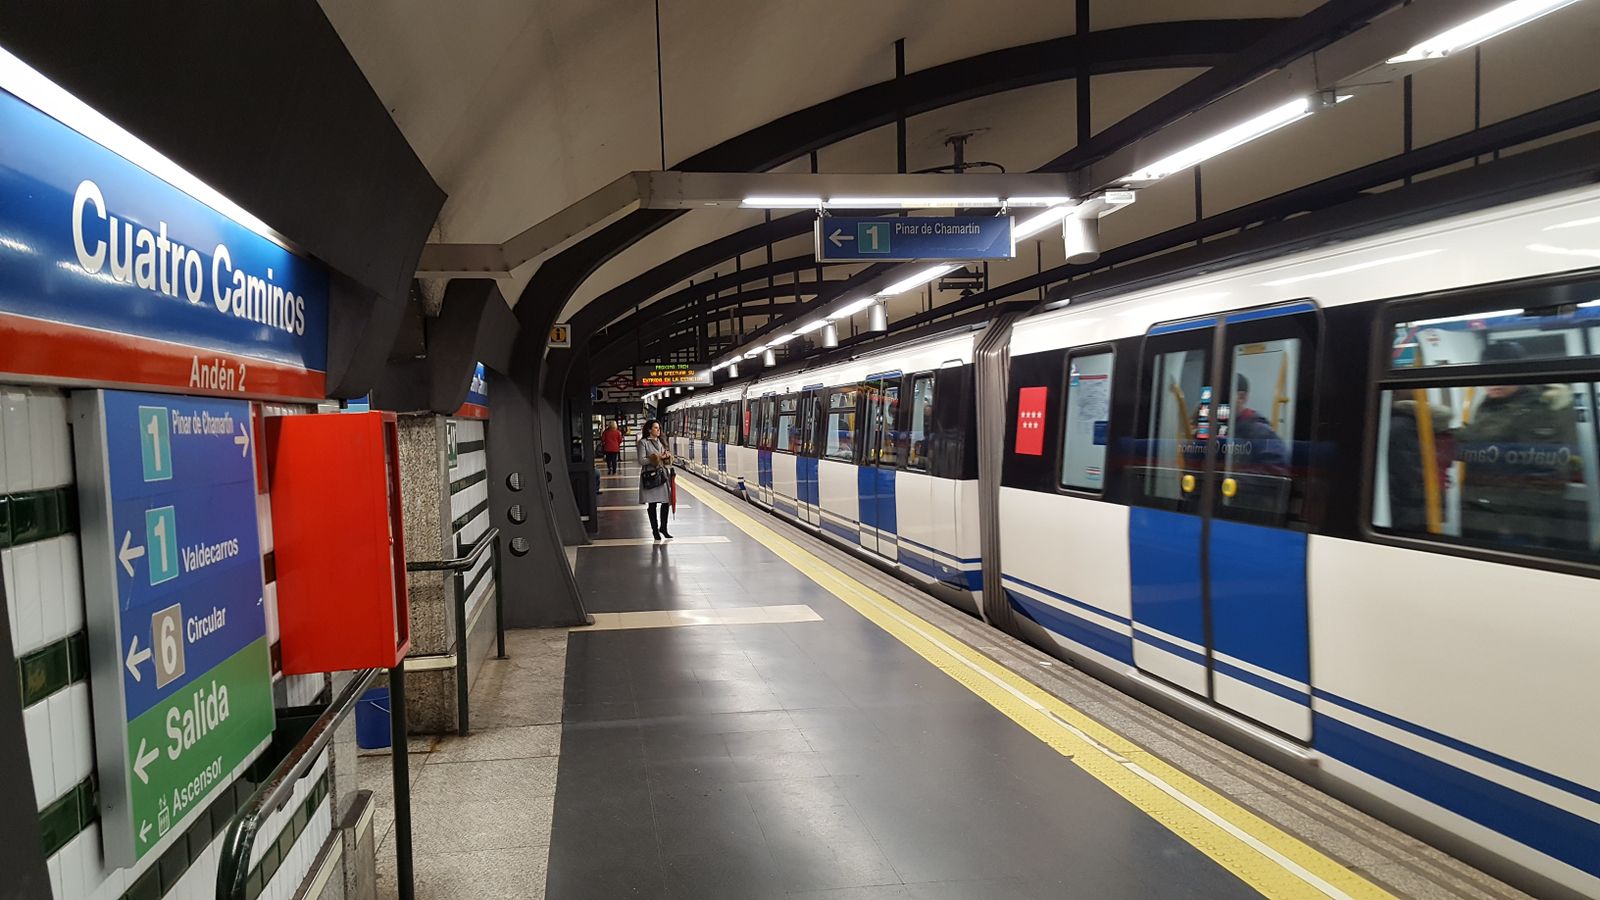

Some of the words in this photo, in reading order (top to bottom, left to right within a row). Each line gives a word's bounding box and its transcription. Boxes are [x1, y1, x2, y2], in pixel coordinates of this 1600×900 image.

[72, 179, 203, 303] Cuatro
[212, 243, 305, 336] Caminos
[866, 225, 879, 249] 1
[896, 222, 918, 234] Pinar
[921, 222, 932, 235] de
[934, 222, 980, 235] Chamartín
[189, 356, 234, 391] Andén
[239, 364, 246, 392] 2
[147, 415, 162, 471] 1
[172, 409, 191, 434] Pinar
[193, 410, 201, 434] de
[202, 410, 234, 434] Chamartín
[154, 515, 168, 572] 1
[182, 537, 239, 573] Valdecarros
[161, 615, 177, 675] 6
[187, 606, 226, 644] Circular
[166, 680, 230, 761] Salida
[172, 754, 223, 816] Ascensor
